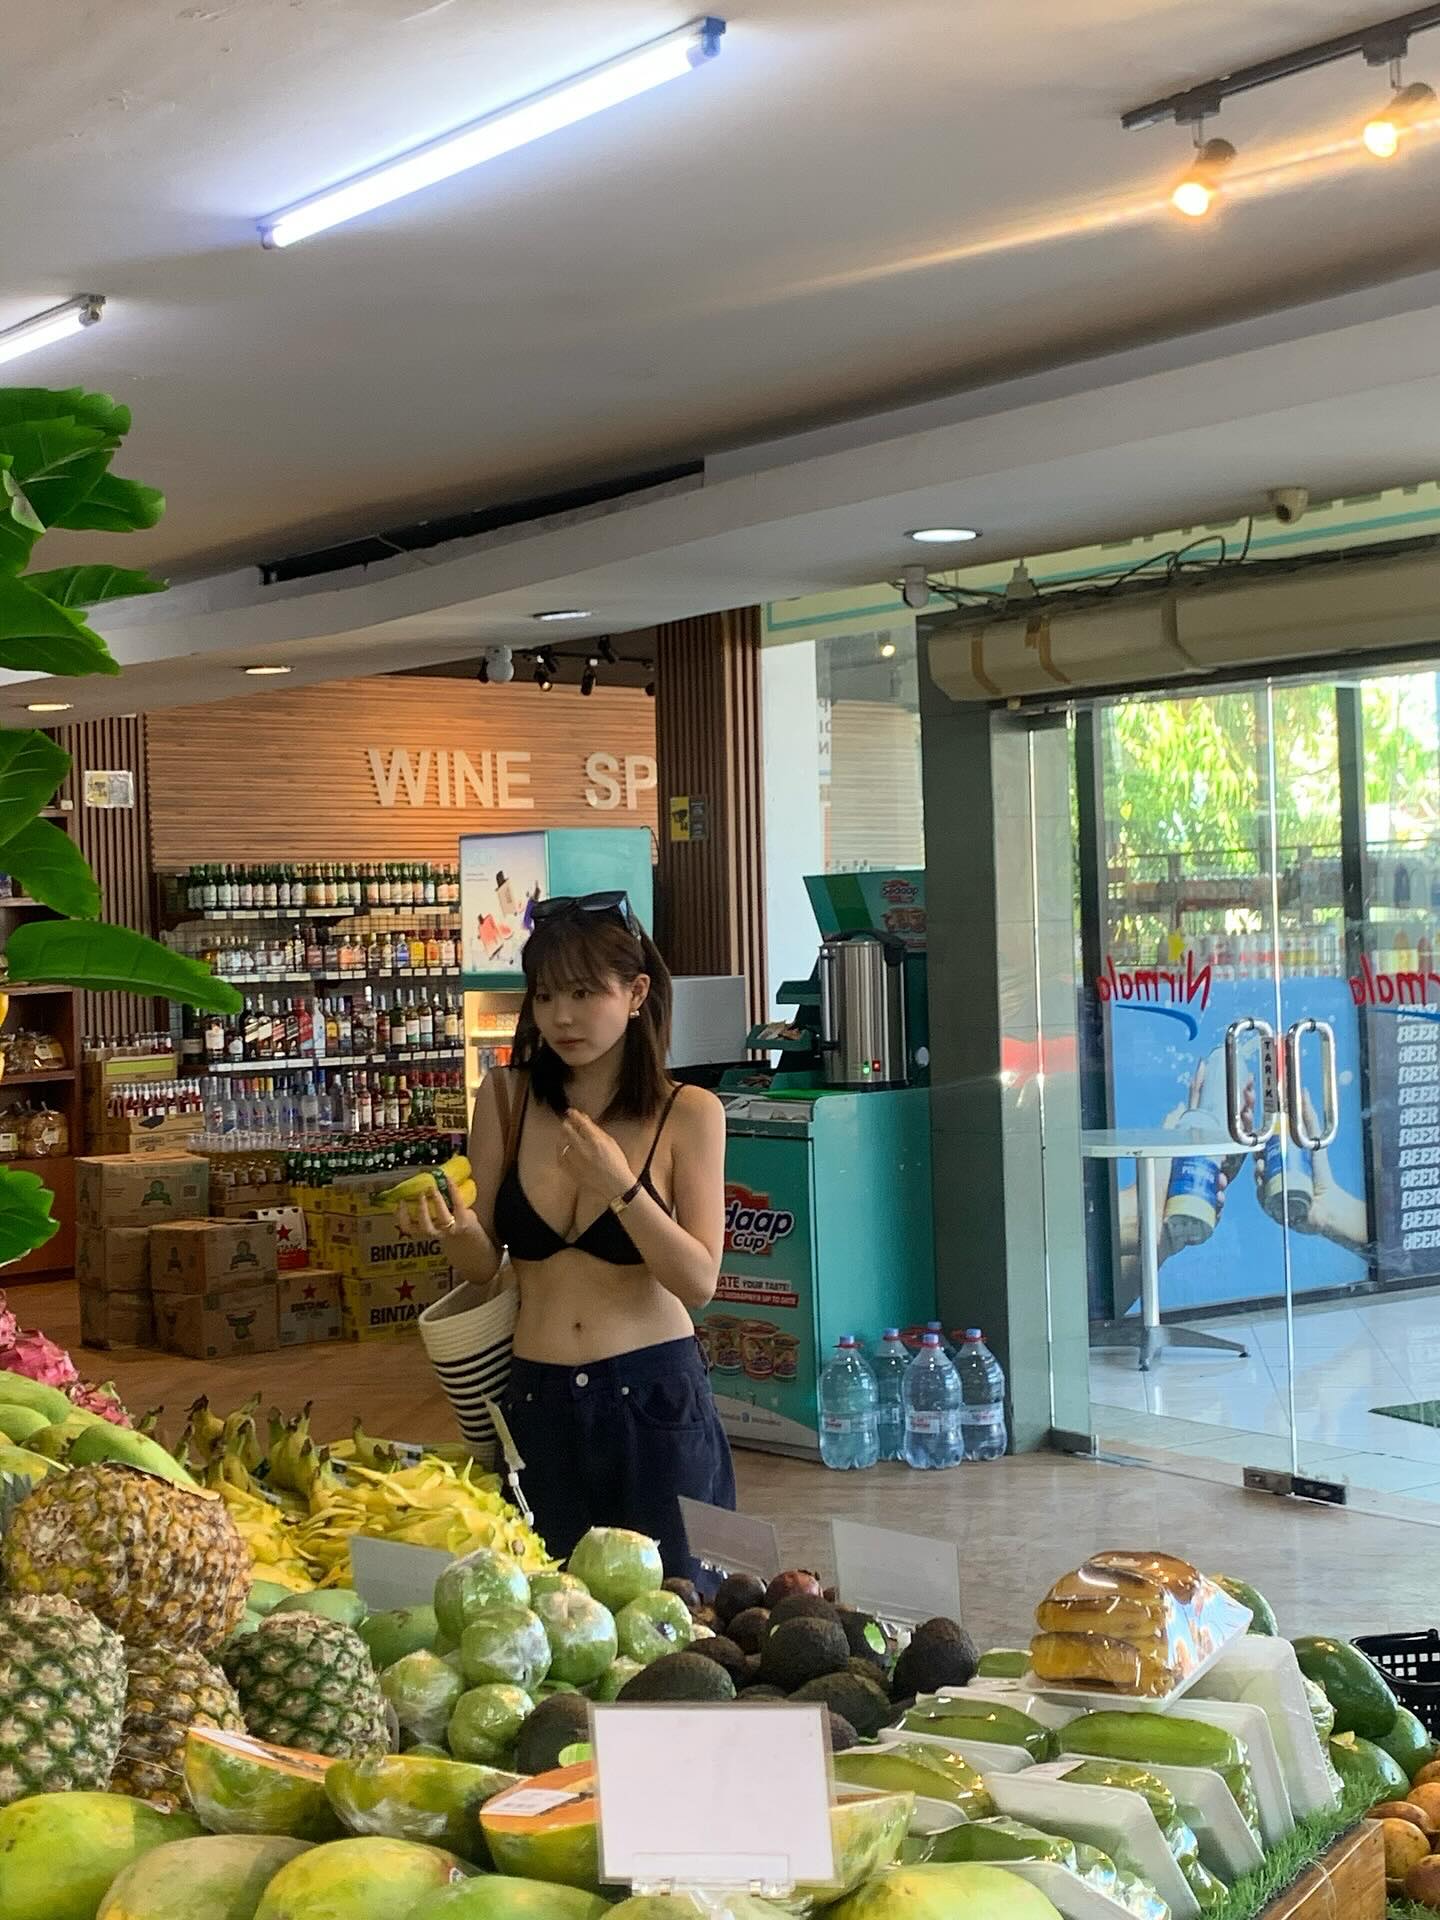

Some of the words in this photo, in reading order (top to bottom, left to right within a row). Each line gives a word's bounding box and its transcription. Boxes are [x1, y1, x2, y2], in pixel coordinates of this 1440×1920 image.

[367, 748, 534, 809] WINE
[584, 751, 657, 810] SP
[1399, 1044, 1438, 1065] BEER
[1264, 1041, 1273, 1098] TARIK
[1400, 1106, 1439, 1127] BEER
[1400, 1167, 1440, 1188] BEER
[371, 1239, 442, 1263] BINTANG
[733, 1233, 765, 1252] Cup
[717, 1276, 739, 1289] ATE
